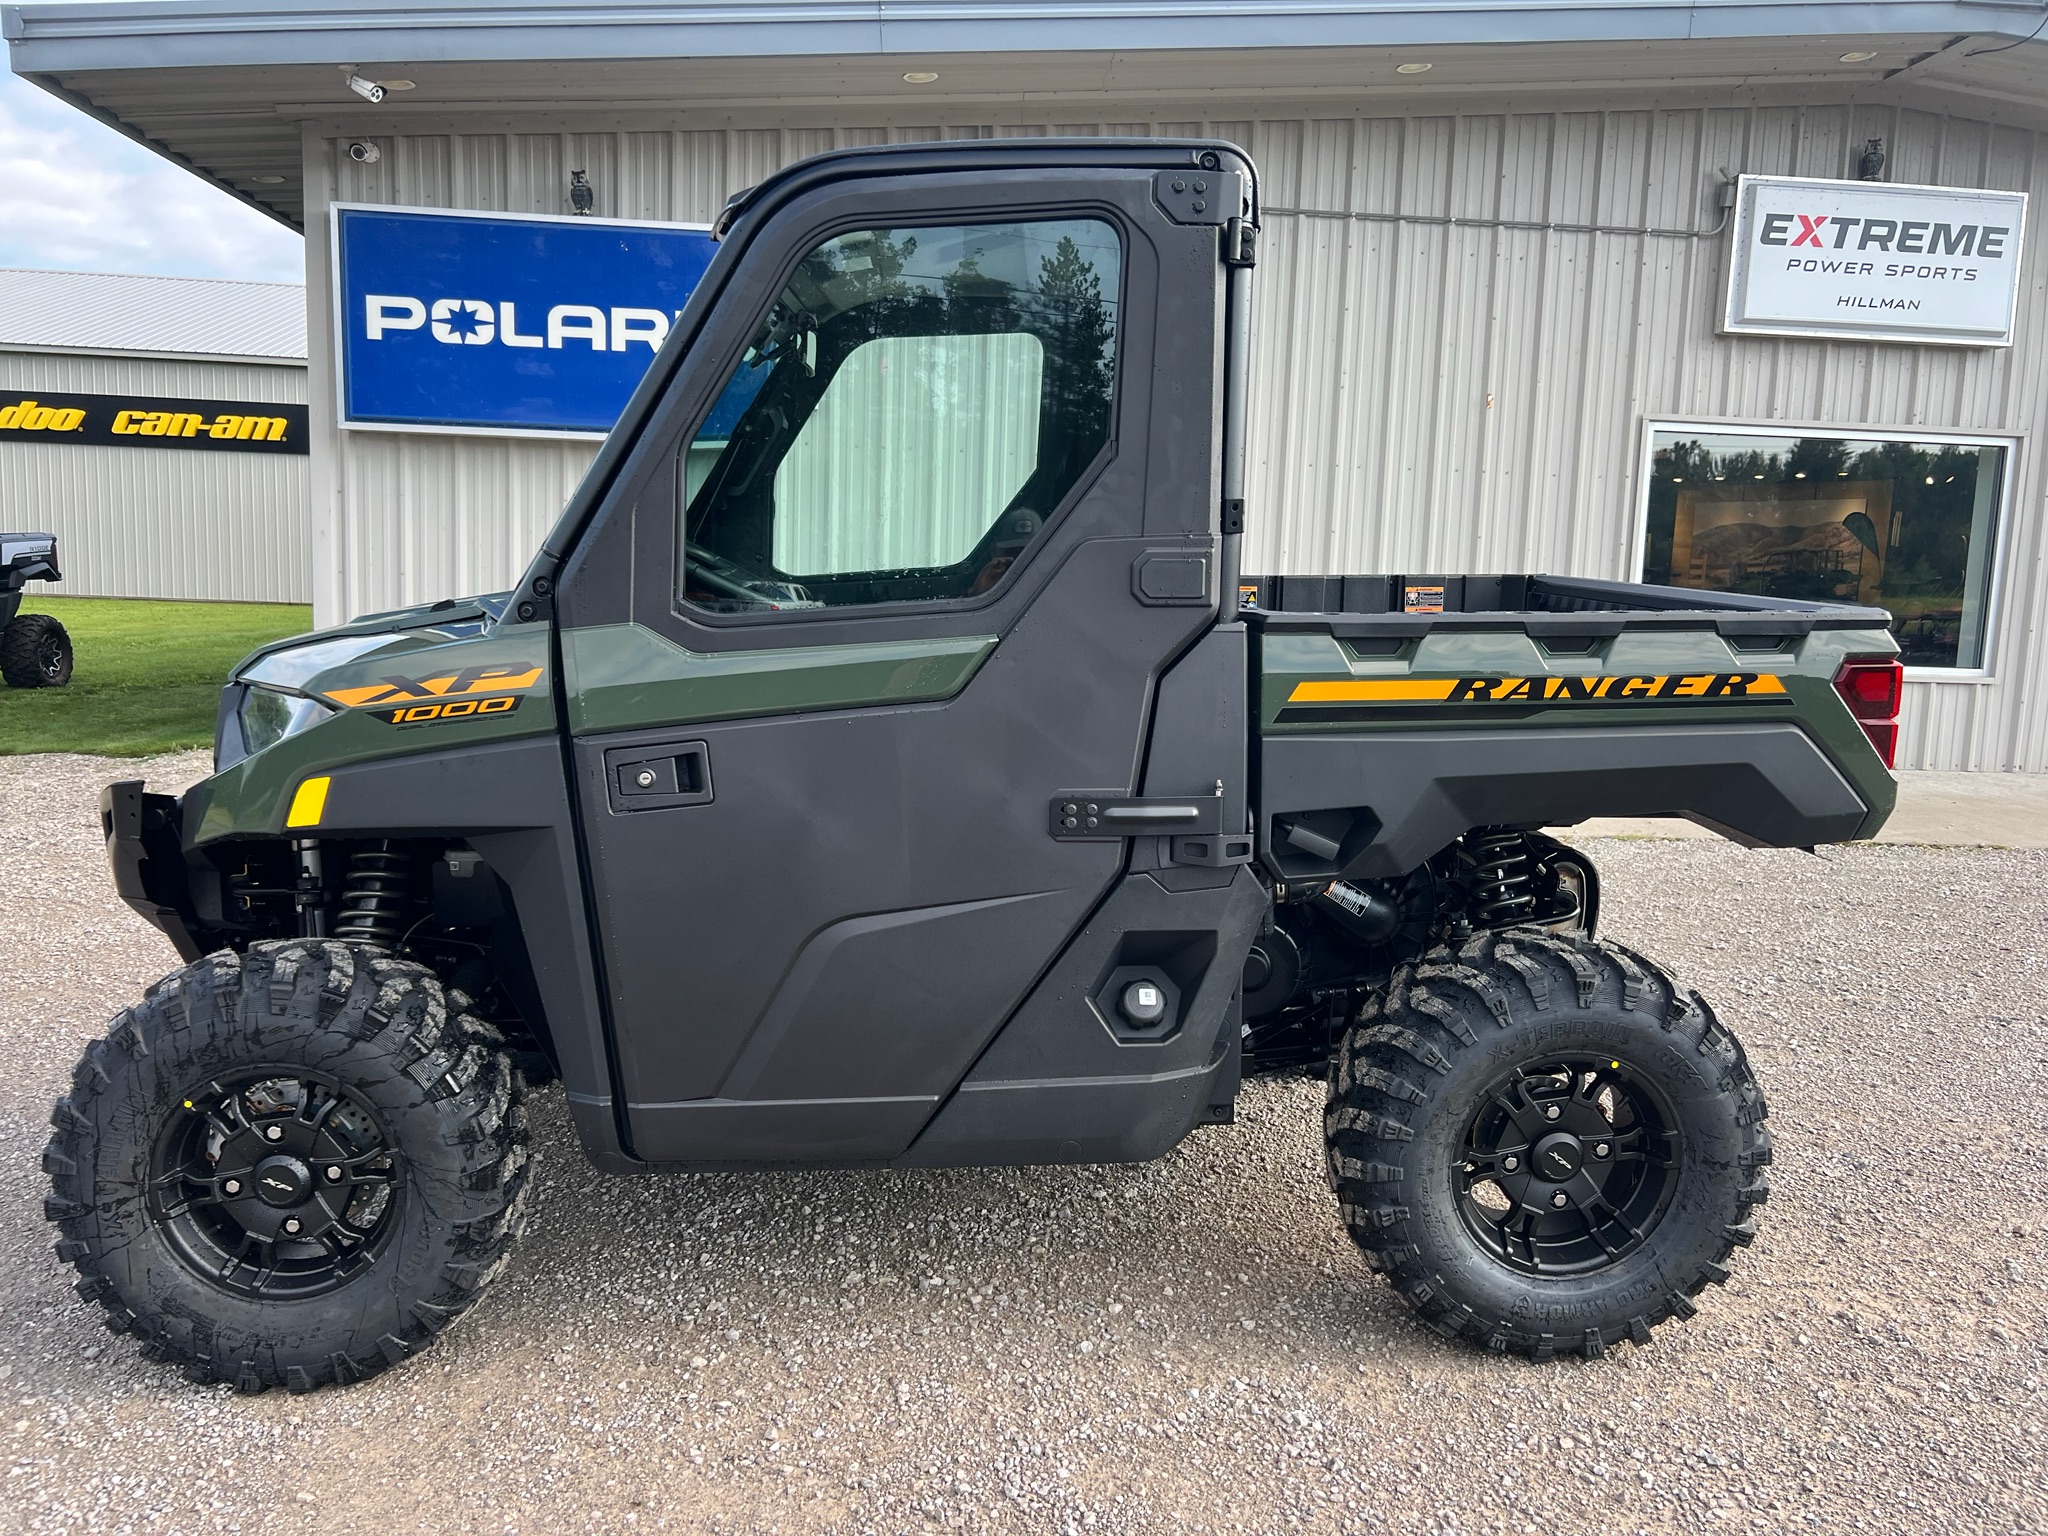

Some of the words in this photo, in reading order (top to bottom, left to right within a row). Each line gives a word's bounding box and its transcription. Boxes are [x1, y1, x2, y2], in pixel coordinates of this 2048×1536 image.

[1760, 213, 2009, 258] EXTREME
[1786, 259, 1874, 275] POWER
[1884, 264, 1978, 281] SPORTS
[1836, 296, 1921, 310] HILLMAN
[366, 295, 682, 353] POLAR
[111, 410, 287, 441] can-am
[352, 661, 536, 704] XP
[1443, 672, 1759, 702] RANGER
[392, 697, 515, 723] 1000
